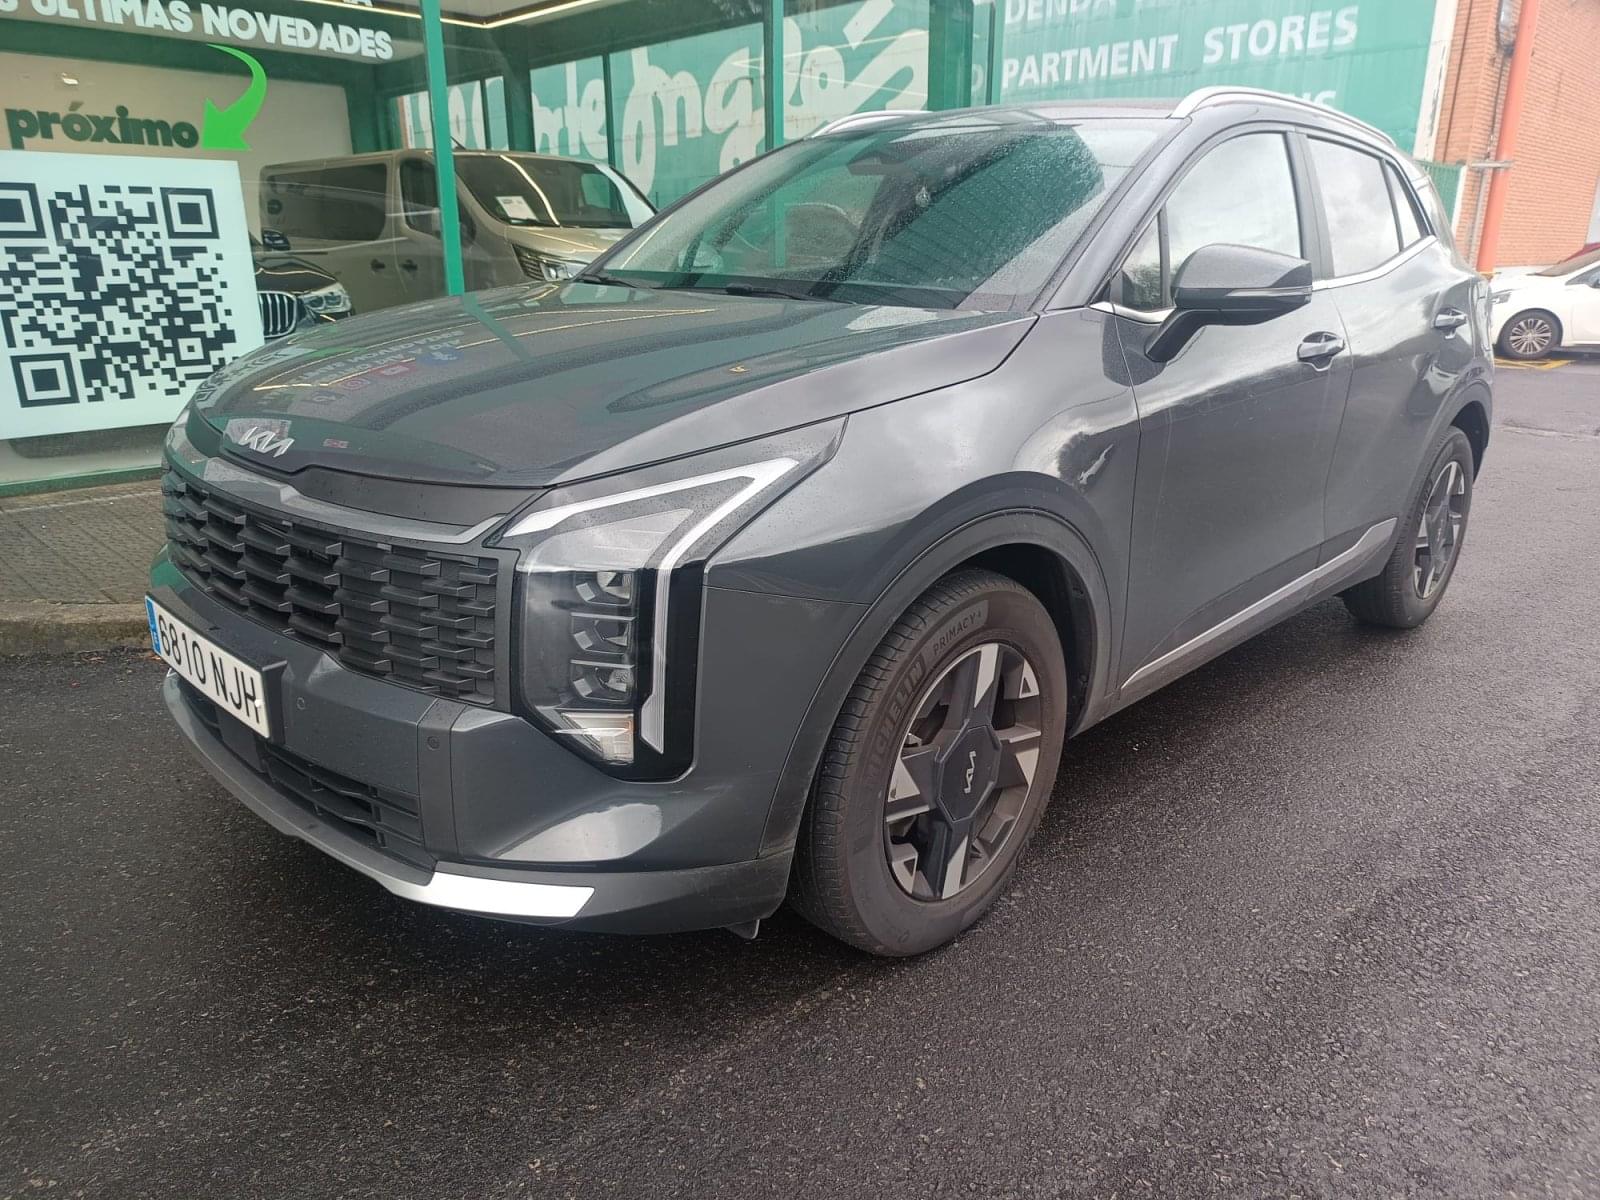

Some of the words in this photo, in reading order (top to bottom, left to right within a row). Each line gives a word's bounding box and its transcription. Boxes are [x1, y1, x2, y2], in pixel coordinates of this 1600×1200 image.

[201, 3, 394, 60] NOVEDADES
[1203, 6, 1359, 64] STORES
[5, 102, 199, 149] próximo
[238, 426, 295, 458] KIA
[158, 614, 207, 686] 6810
[932, 615, 977, 657] PRIMACY
